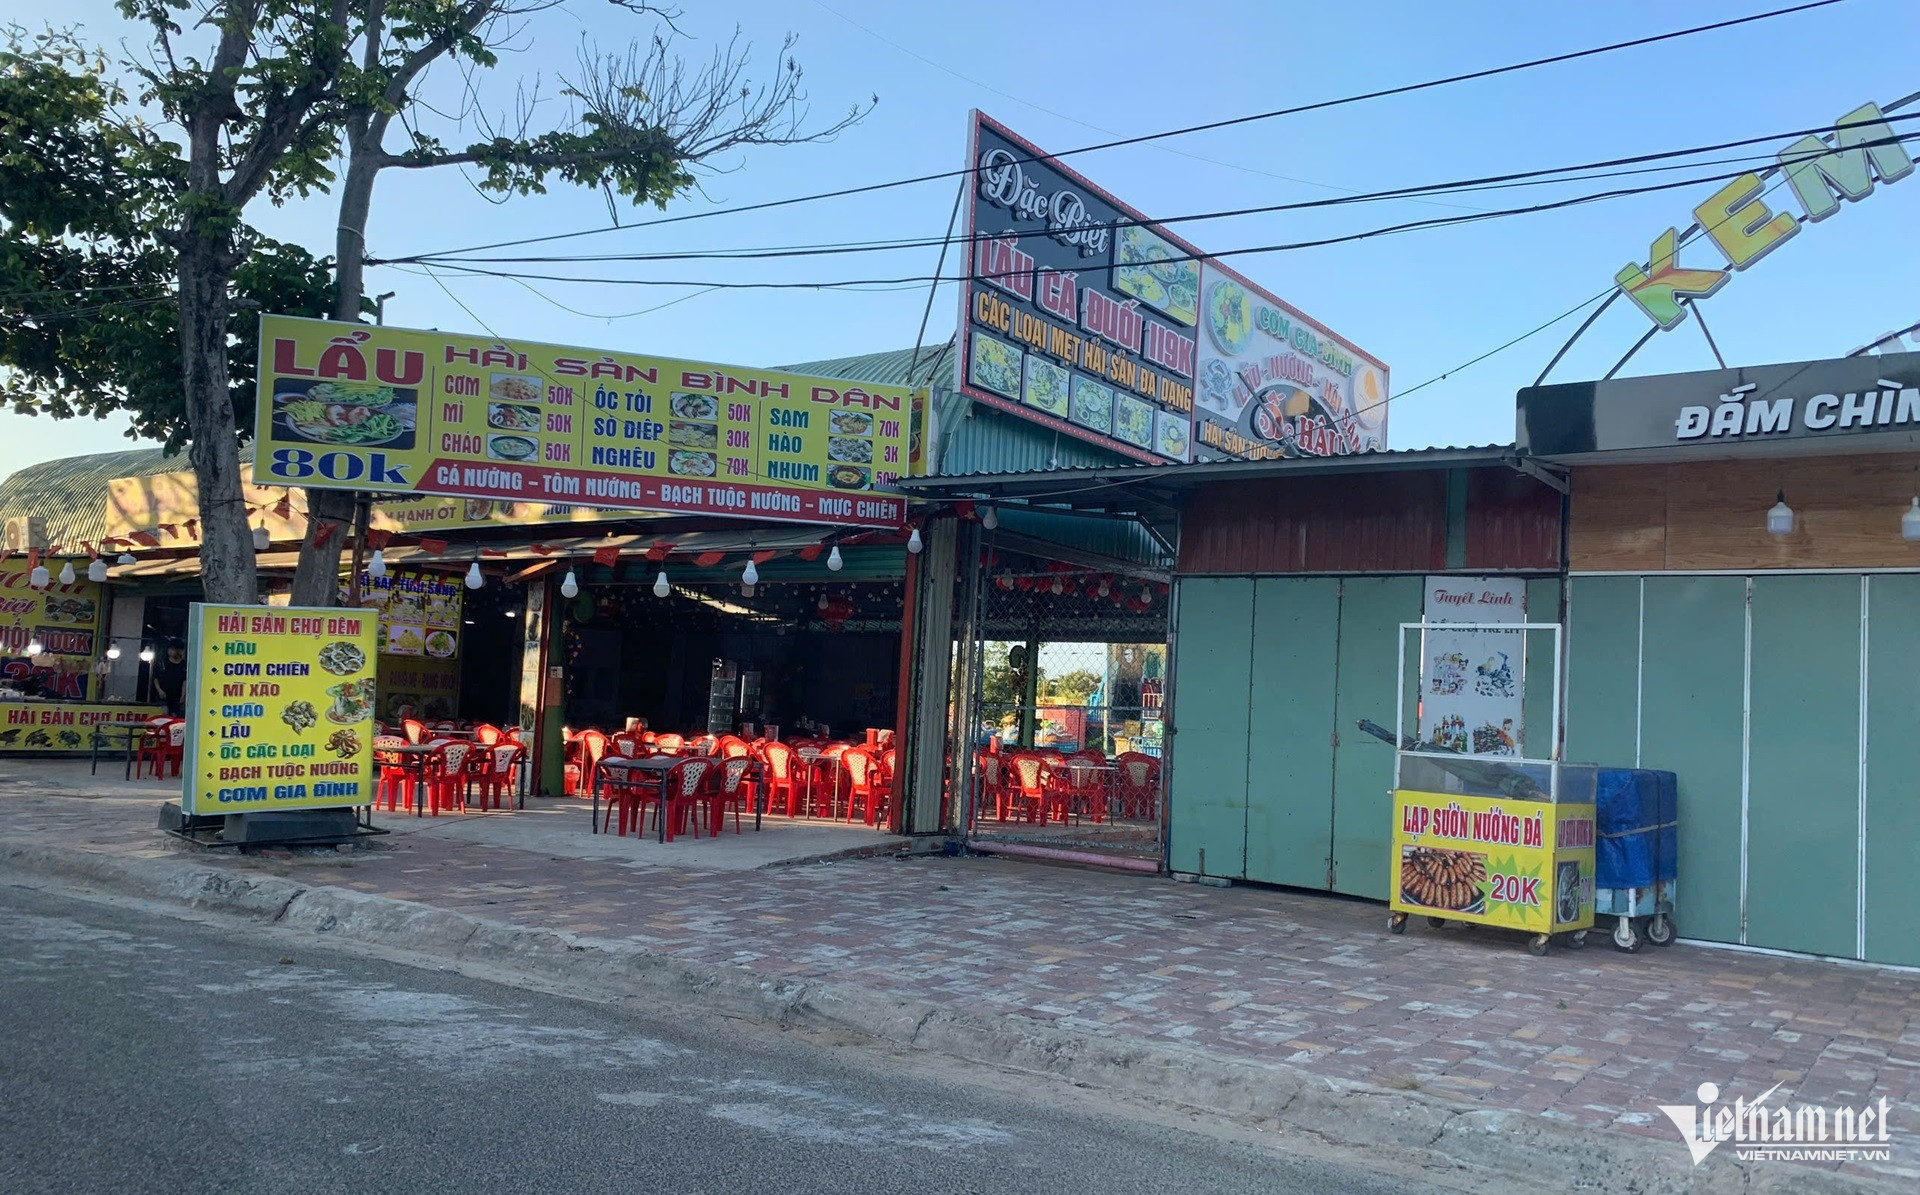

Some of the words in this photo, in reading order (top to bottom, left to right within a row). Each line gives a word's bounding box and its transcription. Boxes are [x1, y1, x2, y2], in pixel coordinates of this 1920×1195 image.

[983, 149, 1048, 219] Đặc
[1053, 190, 1109, 256] Biệt
[1614, 101, 1915, 332] KEM
[1040, 266, 1079, 324] CÁ
[1084, 288, 1143, 355] ĐUỐI
[1148, 320, 1195, 379] 119K
[1259, 306, 1290, 340] CƠM
[1294, 327, 1318, 358] GIA
[977, 289, 1010, 332] CÁC
[1014, 309, 1048, 353] LOẠI
[1051, 325, 1081, 366] MẸT
[1084, 338, 1107, 376] HẢI
[1110, 349, 1136, 388] SẢN
[1139, 369, 1156, 398] ĐA
[1160, 376, 1191, 412] DẠNG
[273, 331, 425, 385] LẨU
[445, 345, 527, 371] HẢI
[553, 357, 658, 384] SẢN
[681, 370, 789, 399] BÌNH
[811, 388, 901, 411] DÂN
[1270, 353, 1314, 386] NƯỚNG
[444, 374, 480, 397] CƠM
[548, 386, 573, 406] 50K
[595, 383, 618, 410] ỐC
[625, 389, 652, 413] TỎI
[728, 403, 751, 422] 50K
[443, 401, 464, 423] MÌ
[547, 414, 572, 433] 50K
[770, 408, 809, 429] SAM
[879, 420, 900, 438] 70K
[1675, 383, 1794, 440] ĐẮM
[442, 431, 482, 455] CHÁO
[545, 443, 571, 462] 50K
[726, 429, 750, 448] 30K
[768, 431, 802, 454] HÀO
[884, 446, 898, 463] 3K
[1204, 419, 1222, 446] HẢI
[592, 446, 656, 469] NGHÊU
[726, 457, 749, 476] 70K
[767, 460, 819, 482] NHUM
[436, 464, 460, 486] CÁ
[464, 467, 523, 491] NƯỚNG
[543, 472, 579, 495] TÔM
[585, 476, 641, 500] NƯỚNG
[661, 484, 702, 507] BẠCH
[708, 487, 746, 510] TUỘC
[751, 490, 801, 512] NƯỚNG
[819, 497, 851, 519] MỰC
[856, 499, 898, 520] CHIÊN
[1433, 588, 1475, 606] Tuyết
[218, 610, 247, 633] HẢI
[251, 612, 286, 635] SẢN
[290, 616, 324, 639] CHỢ
[327, 617, 361, 636] ĐÊM
[223, 662, 261, 676] CƠM
[265, 661, 310, 676] CHIÊN
[8, 706, 36, 724] HẢI
[41, 707, 75, 725] SẢN
[282, 744, 315, 759] LOẠI
[219, 766, 262, 783] BẠCH
[266, 762, 305, 780] TUỘC
[218, 786, 268, 803] CƠM
[274, 784, 307, 799] GIA
[1403, 805, 1429, 841] LẠP
[1432, 802, 1469, 839] SƯỜN
[1473, 806, 1520, 845] NƯỚNG
[1523, 810, 1543, 847] ĐÁ
[1490, 874, 1540, 905] 20K
